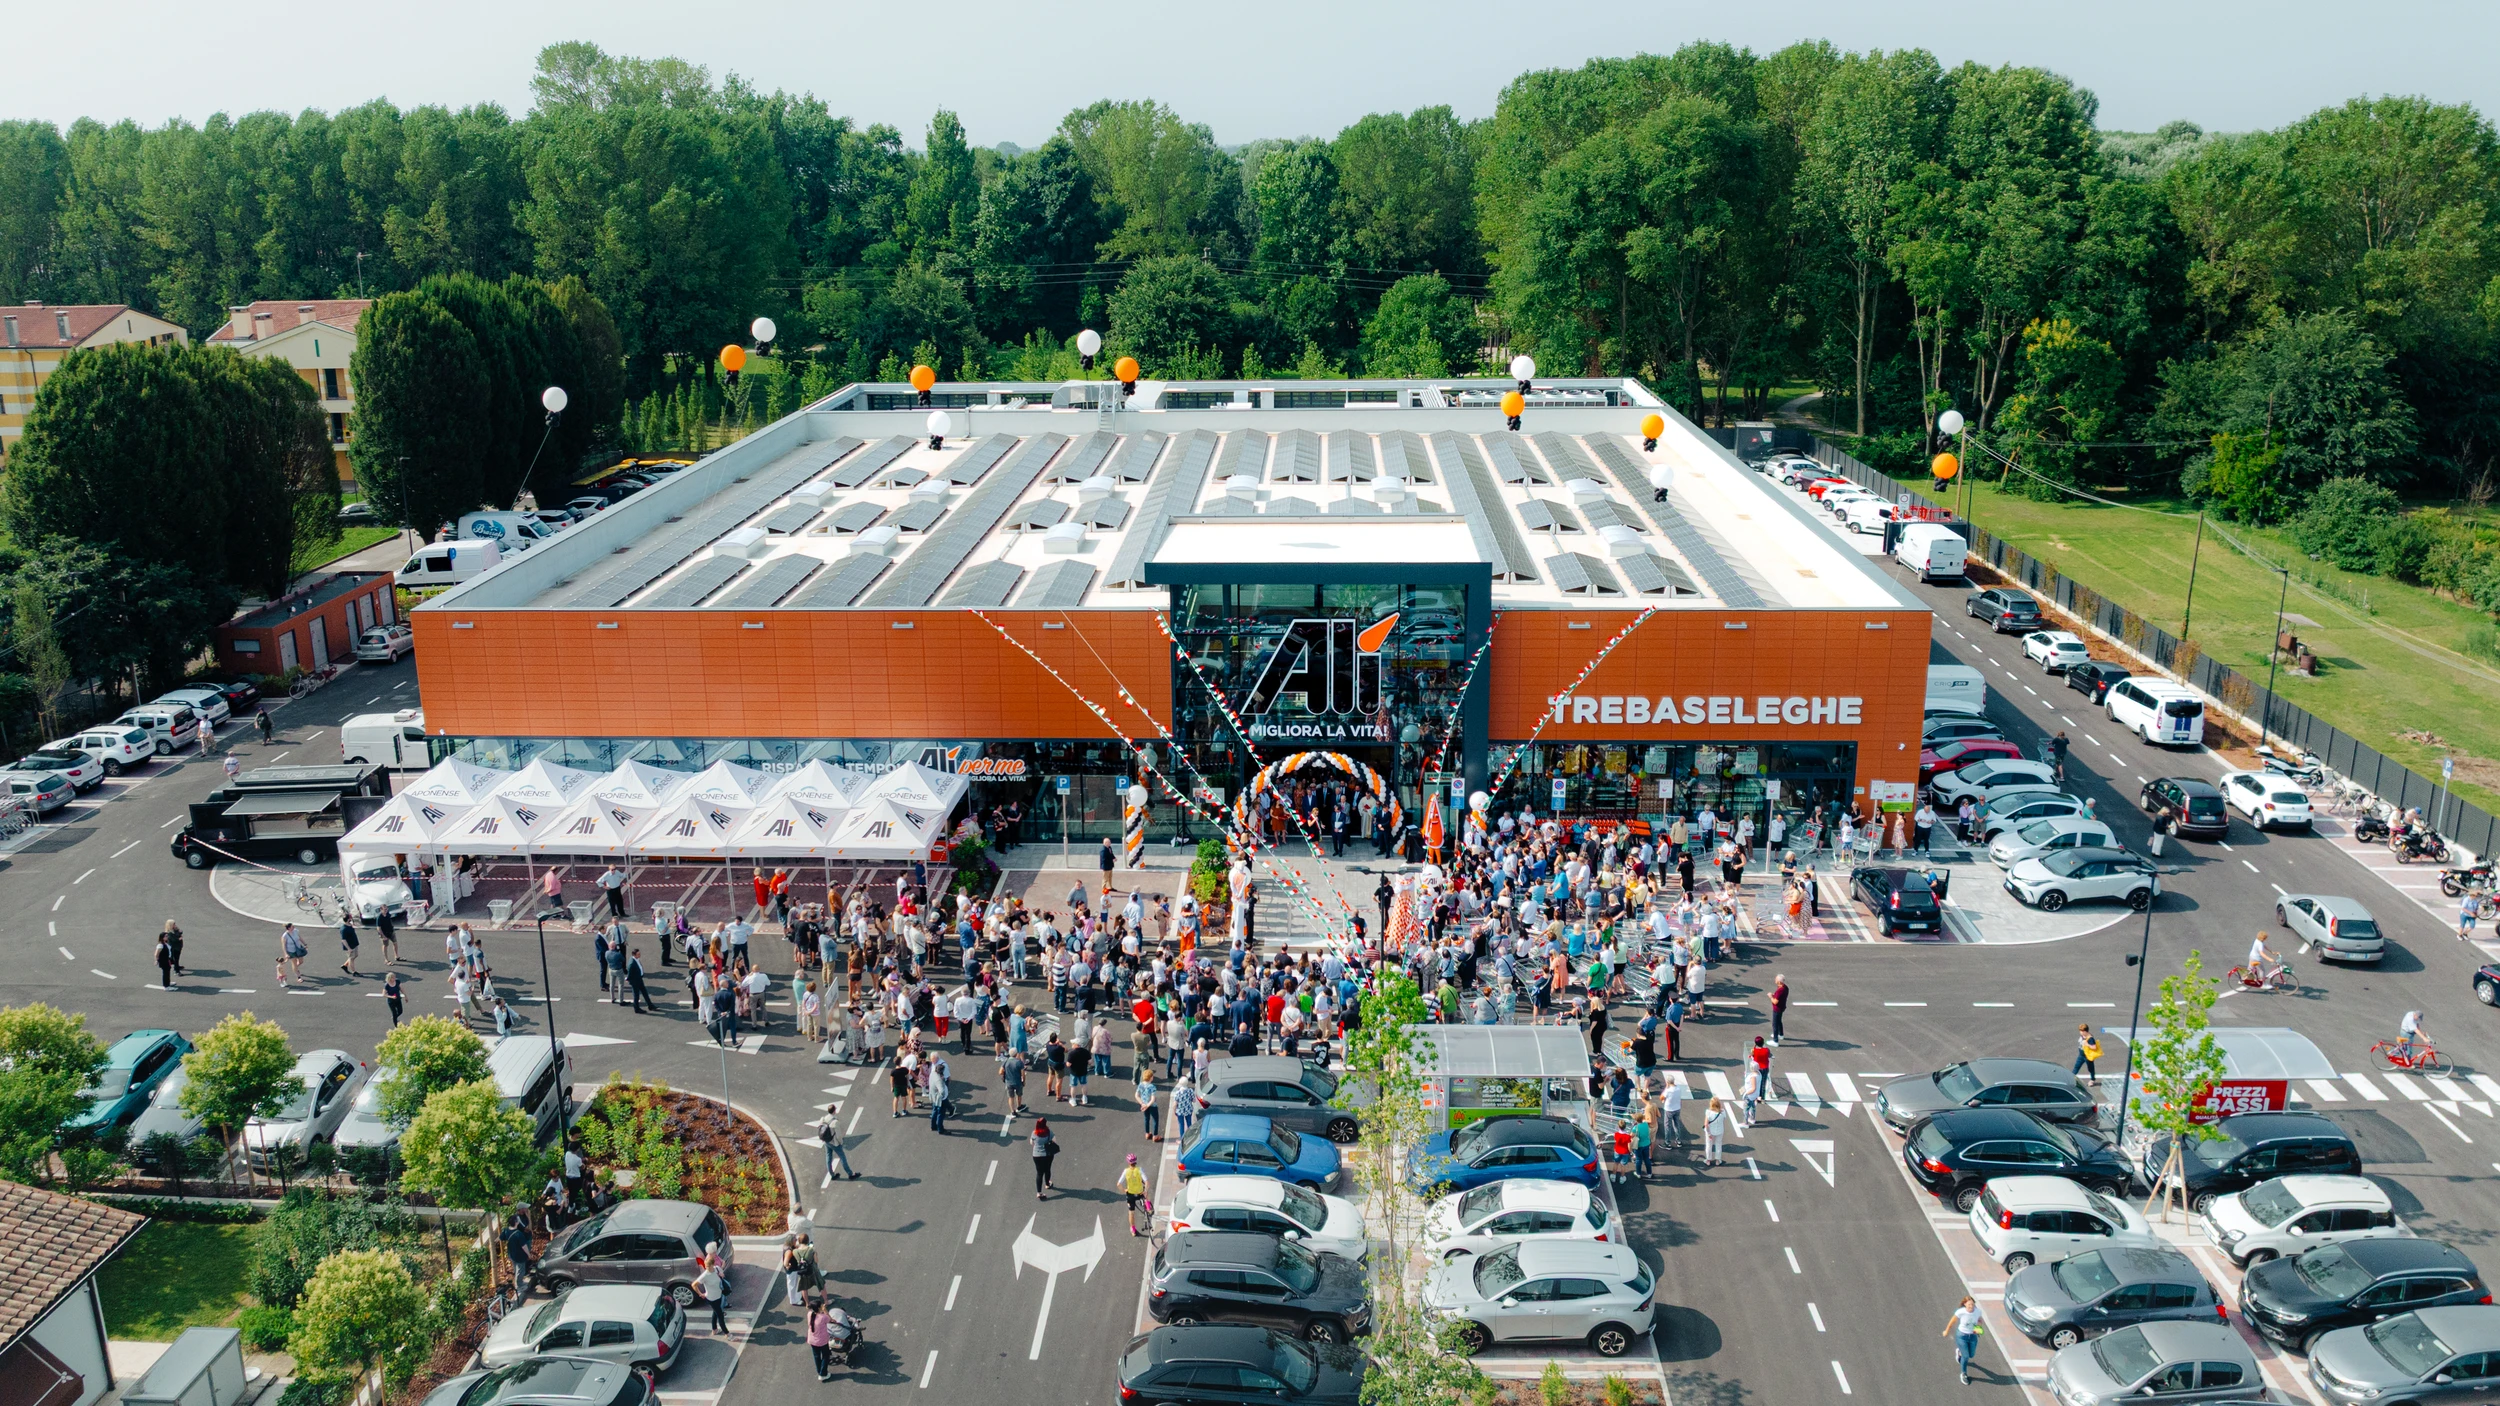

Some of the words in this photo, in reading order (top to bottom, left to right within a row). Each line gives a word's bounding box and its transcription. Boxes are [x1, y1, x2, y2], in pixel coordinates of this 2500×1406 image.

[1547, 696, 1863, 725] TREBASELEGHE
[1250, 724, 1321, 738] MIGLIORA
[1327, 725, 1346, 737] LA
[1350, 724, 1388, 738] VITA!
[1059, 777, 1068, 787] P
[1119, 778, 1127, 787] P
[502, 790, 551, 798] APONENSE
[594, 792, 644, 800] APONENSE
[690, 792, 740, 800] APONENSE
[782, 792, 834, 800] APONENSE
[876, 792, 929, 801] APONENSE
[1482, 1085, 1504, 1094] 230
[2212, 1086, 2267, 1098] PREZZI
[2206, 1097, 2271, 1112] BASSI
